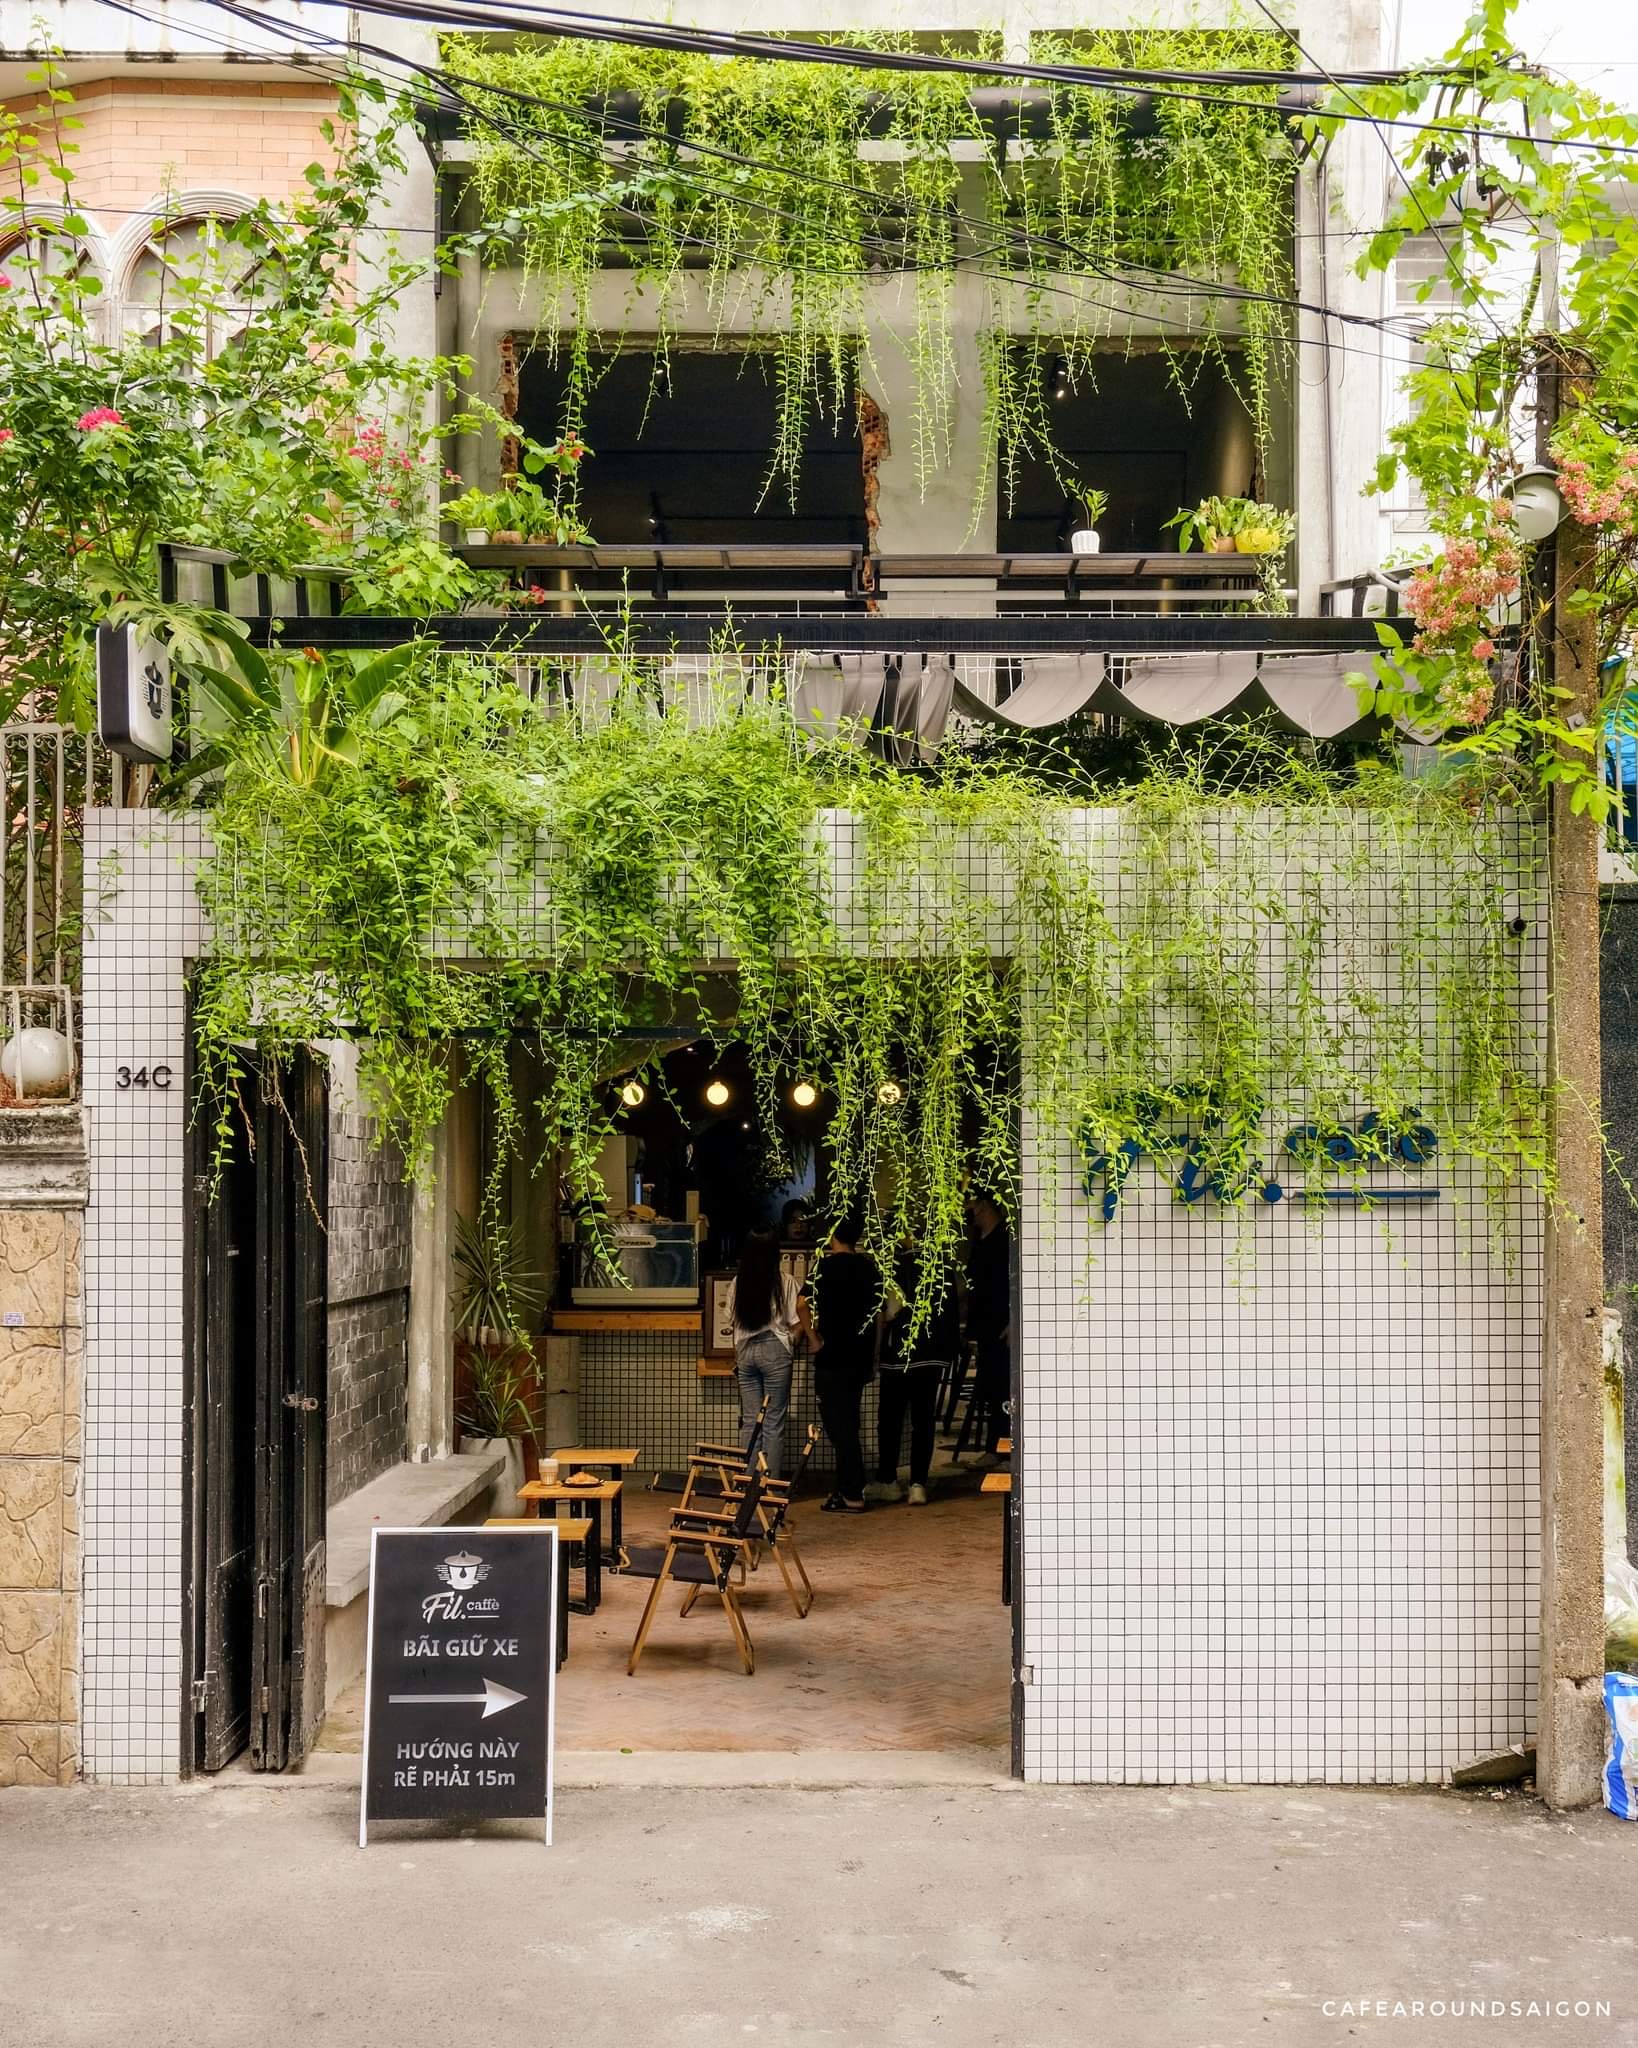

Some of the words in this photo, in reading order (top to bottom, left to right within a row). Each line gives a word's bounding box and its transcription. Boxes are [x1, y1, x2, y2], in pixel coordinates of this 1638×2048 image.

[116, 1065, 172, 1088] 34C
[466, 1598, 500, 1611] caffè
[403, 1634, 440, 1657] BÃI
[445, 1634, 489, 1657] GIỮ
[492, 1639, 519, 1656] XE
[397, 1737, 473, 1760] HƯỚNG
[479, 1737, 520, 1759] NÀY
[394, 1765, 417, 1787] RẼ
[422, 1763, 471, 1787] PHẢI
[476, 1770, 515, 1787] 15m
